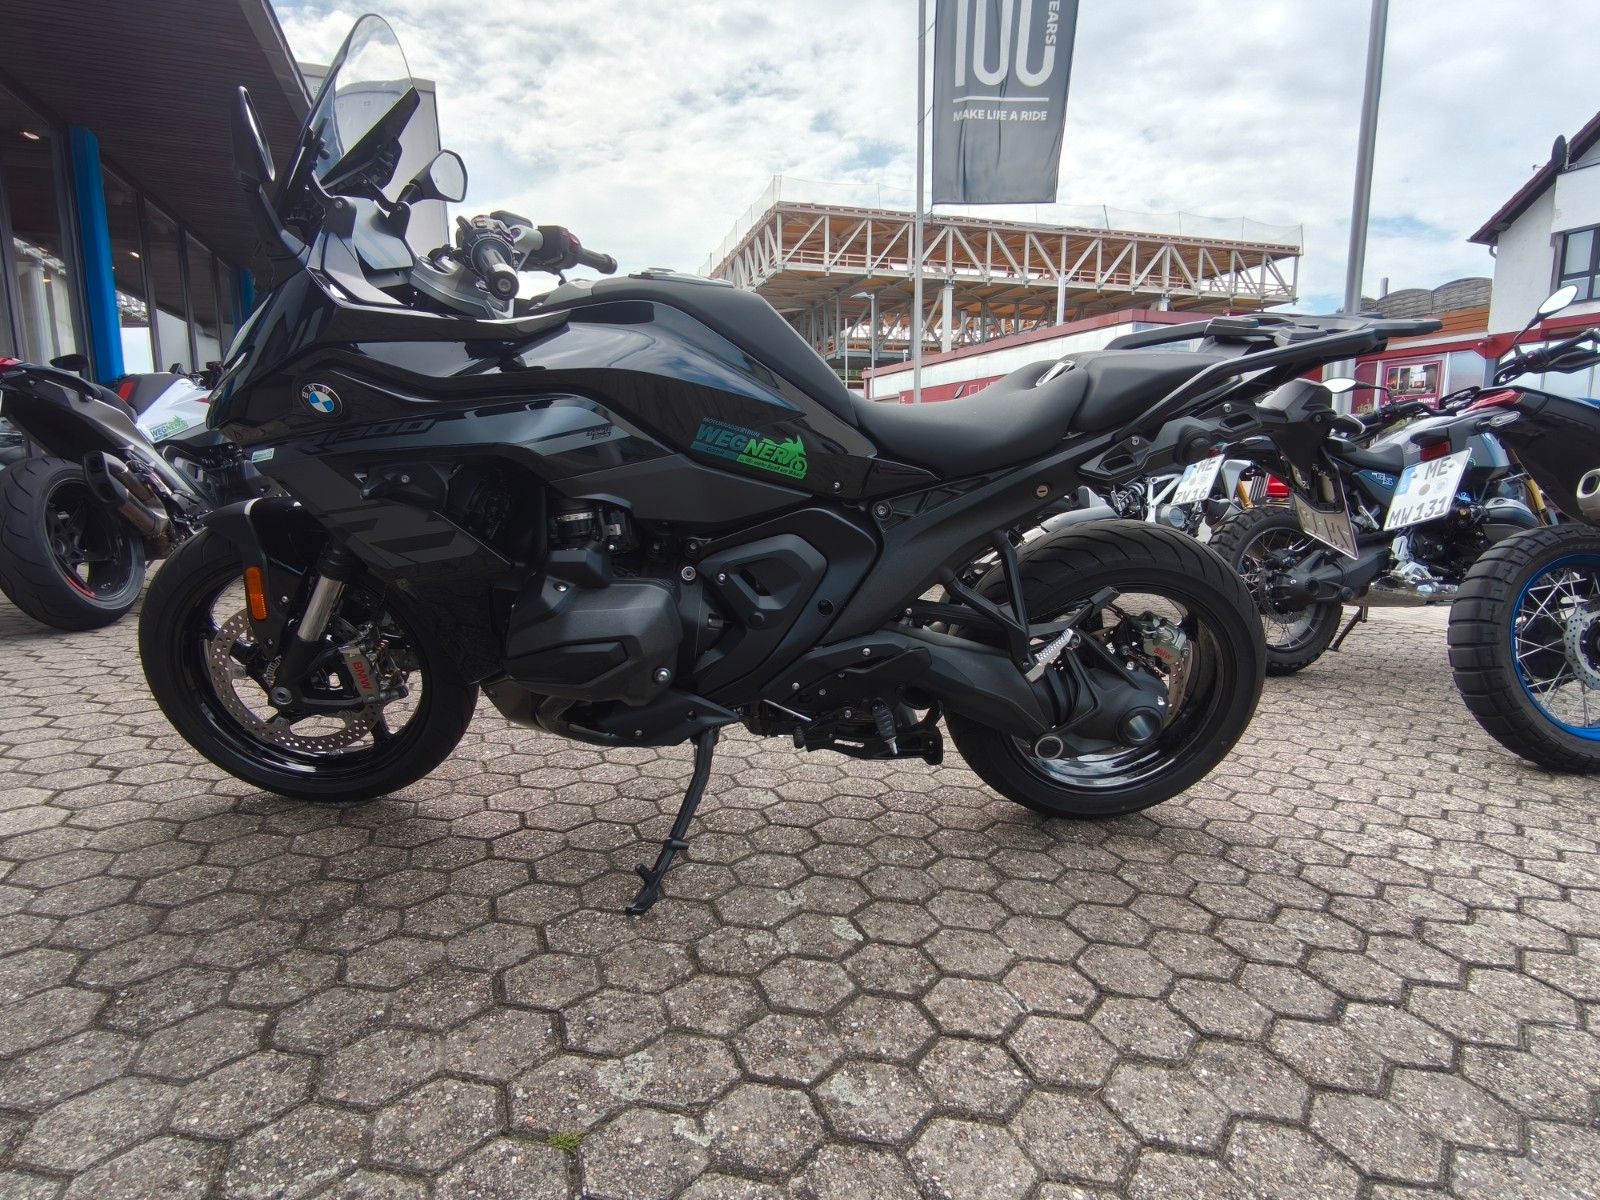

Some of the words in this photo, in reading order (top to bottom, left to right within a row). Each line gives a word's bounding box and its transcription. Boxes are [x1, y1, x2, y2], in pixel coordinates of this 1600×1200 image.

[952, 109, 985, 122] MAKE
[986, 110, 1007, 121] LIFE
[1009, 110, 1018, 121] A
[1019, 111, 1048, 121] RIDE
[302, 384, 330, 399] BMW
[696, 423, 786, 465] WEGNER
[1424, 456, 1451, 480] ME
[1387, 505, 1413, 528] MW
[1413, 496, 1447, 522] 131
[1152, 645, 1174, 660] BMW
[352, 660, 373, 690] BMW
